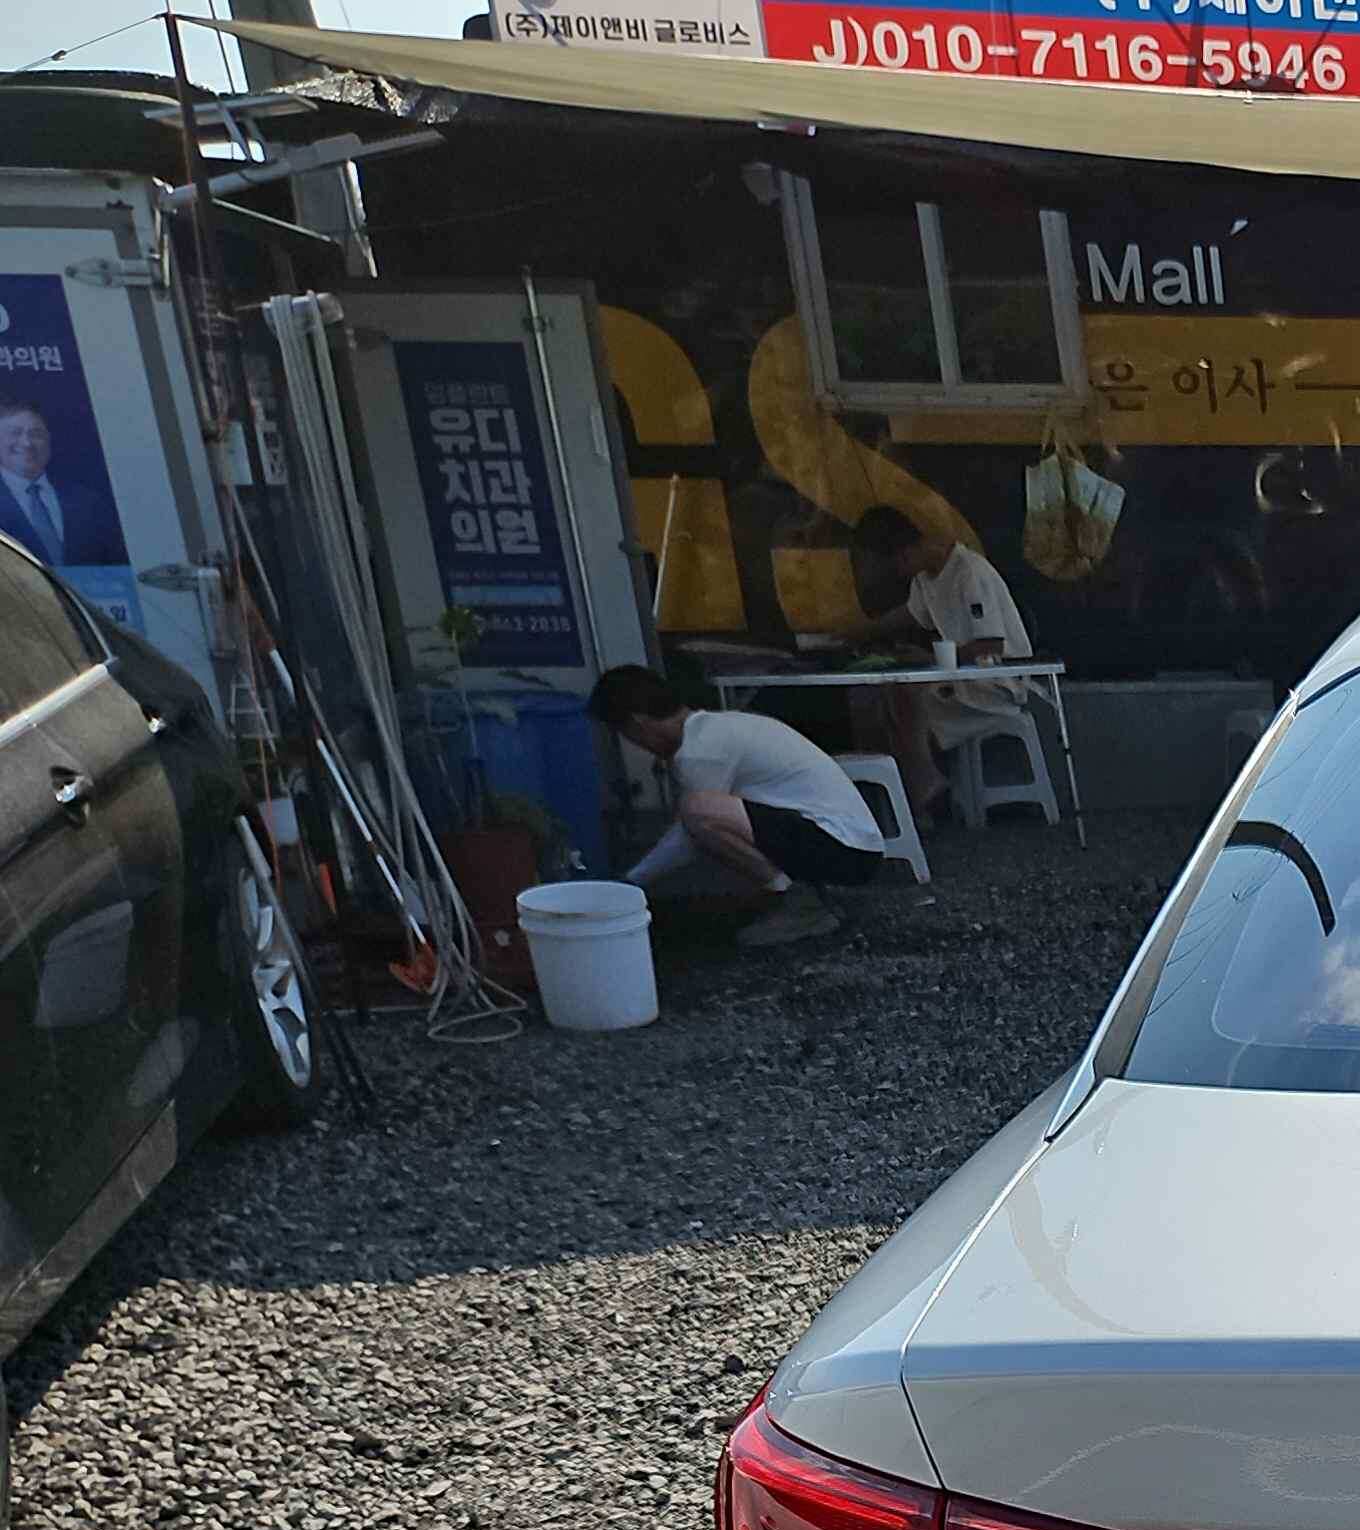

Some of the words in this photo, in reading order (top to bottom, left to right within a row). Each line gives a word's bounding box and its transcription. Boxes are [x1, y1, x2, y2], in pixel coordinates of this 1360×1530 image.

[505, 12, 648, 42] (주)제이앤비
[654, 18, 751, 46] 글로비스
[812, 16, 1347, 91] J)010-7116-5946
[1085, 242, 1226, 306] Mall
[1088, 361, 1151, 411] 은
[1172, 355, 1276, 414] 이사
[428, 407, 523, 455] 유디
[437, 458, 533, 506] 치과
[449, 508, 541, 556] 의원
